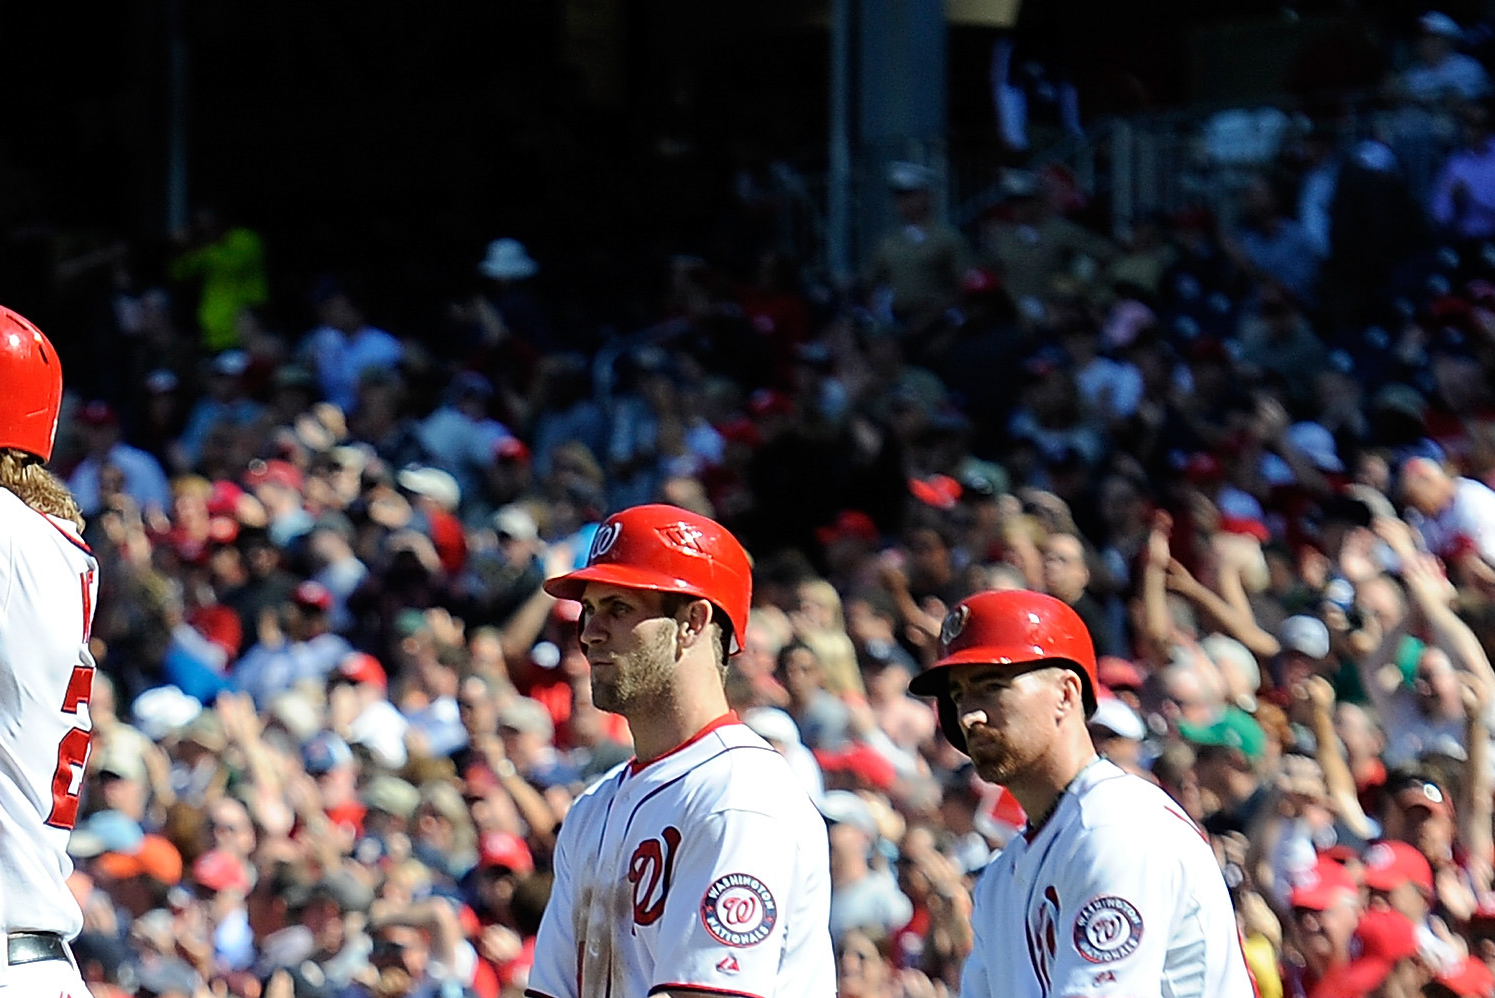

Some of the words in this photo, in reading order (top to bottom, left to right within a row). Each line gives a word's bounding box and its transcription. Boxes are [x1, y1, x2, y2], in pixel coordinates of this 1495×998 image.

[628, 826, 682, 926] W
[708, 874, 775, 911] WASHINGTON
[723, 896, 756, 925] W
[706, 916, 770, 945] NATIONALS
